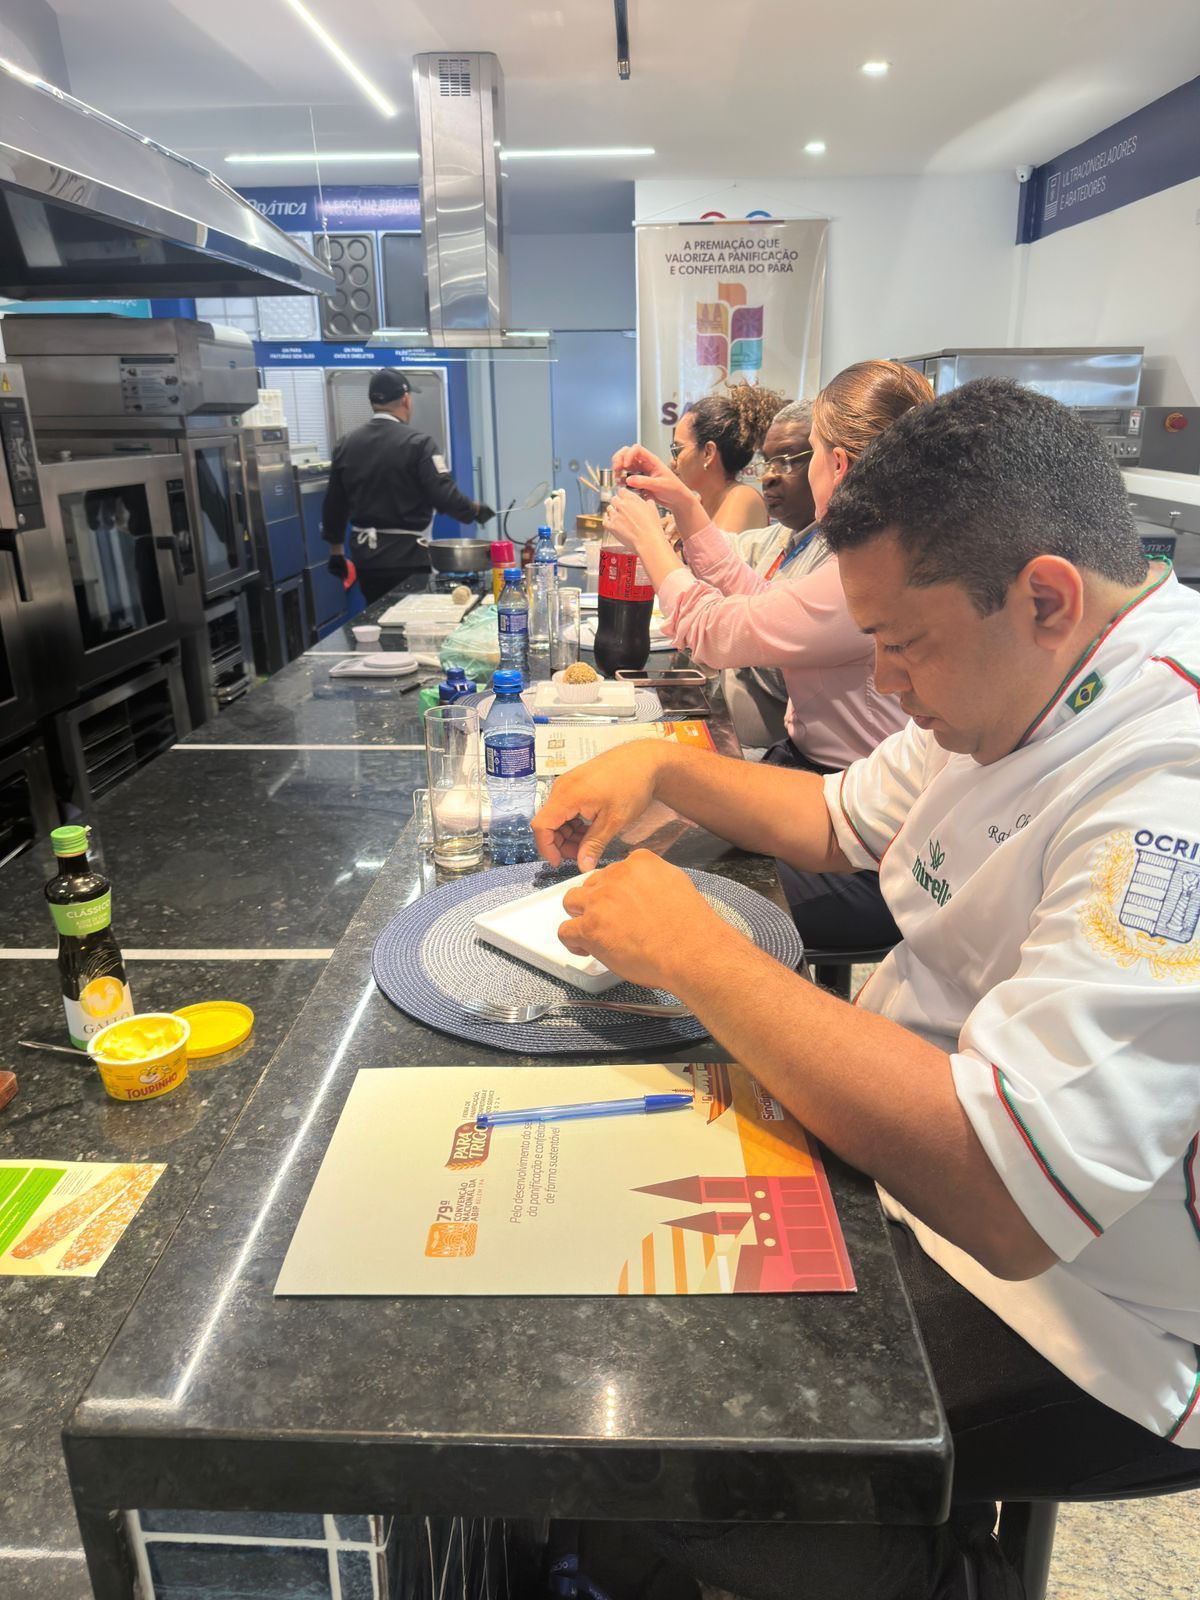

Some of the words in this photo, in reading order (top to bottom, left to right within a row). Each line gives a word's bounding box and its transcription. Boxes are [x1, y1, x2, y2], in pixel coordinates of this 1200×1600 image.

[1062, 135, 1138, 188] ULTRACONGELADORES
[379, 199, 421, 209] PERFEIT
[1060, 194, 1066, 210] E
[1065, 176, 1106, 206] ABATEDORES
[665, 252, 716, 263] VALORIZA
[717, 253, 726, 262] A
[728, 248, 799, 263] PANIFICAÇÃO
[683, 240, 692, 250] A
[694, 237, 755, 253] PREMIAÇÃO
[757, 239, 781, 250] QUE
[670, 265, 676, 275] E
[678, 264, 746, 275] CONFEITARIA
[748, 263, 765, 273] DO
[767, 260, 794, 273] PARÁ
[1134, 829, 1200, 860] OCRI
[66, 899, 111, 919] CLÁSSICO
[124, 1072, 178, 1100] TOURINHO
[469, 1124, 489, 1159] TRIGO
[521, 1130, 532, 1140] do
[548, 1127, 560, 1168] sustentável
[468, 1178, 478, 1188] DA
[513, 1140, 531, 1204] desenvolvimento
[529, 1160, 544, 1205] panificação
[544, 1167, 558, 1193] forma
[453, 1182, 469, 1222] CONVENÇÃO
[462, 1189, 475, 1222] NACIONAL
[544, 1193, 555, 1204] de
[471, 1205, 480, 1222] ABIP
[509, 1205, 523, 1224] Pelo
[527, 1206, 538, 1217] da
